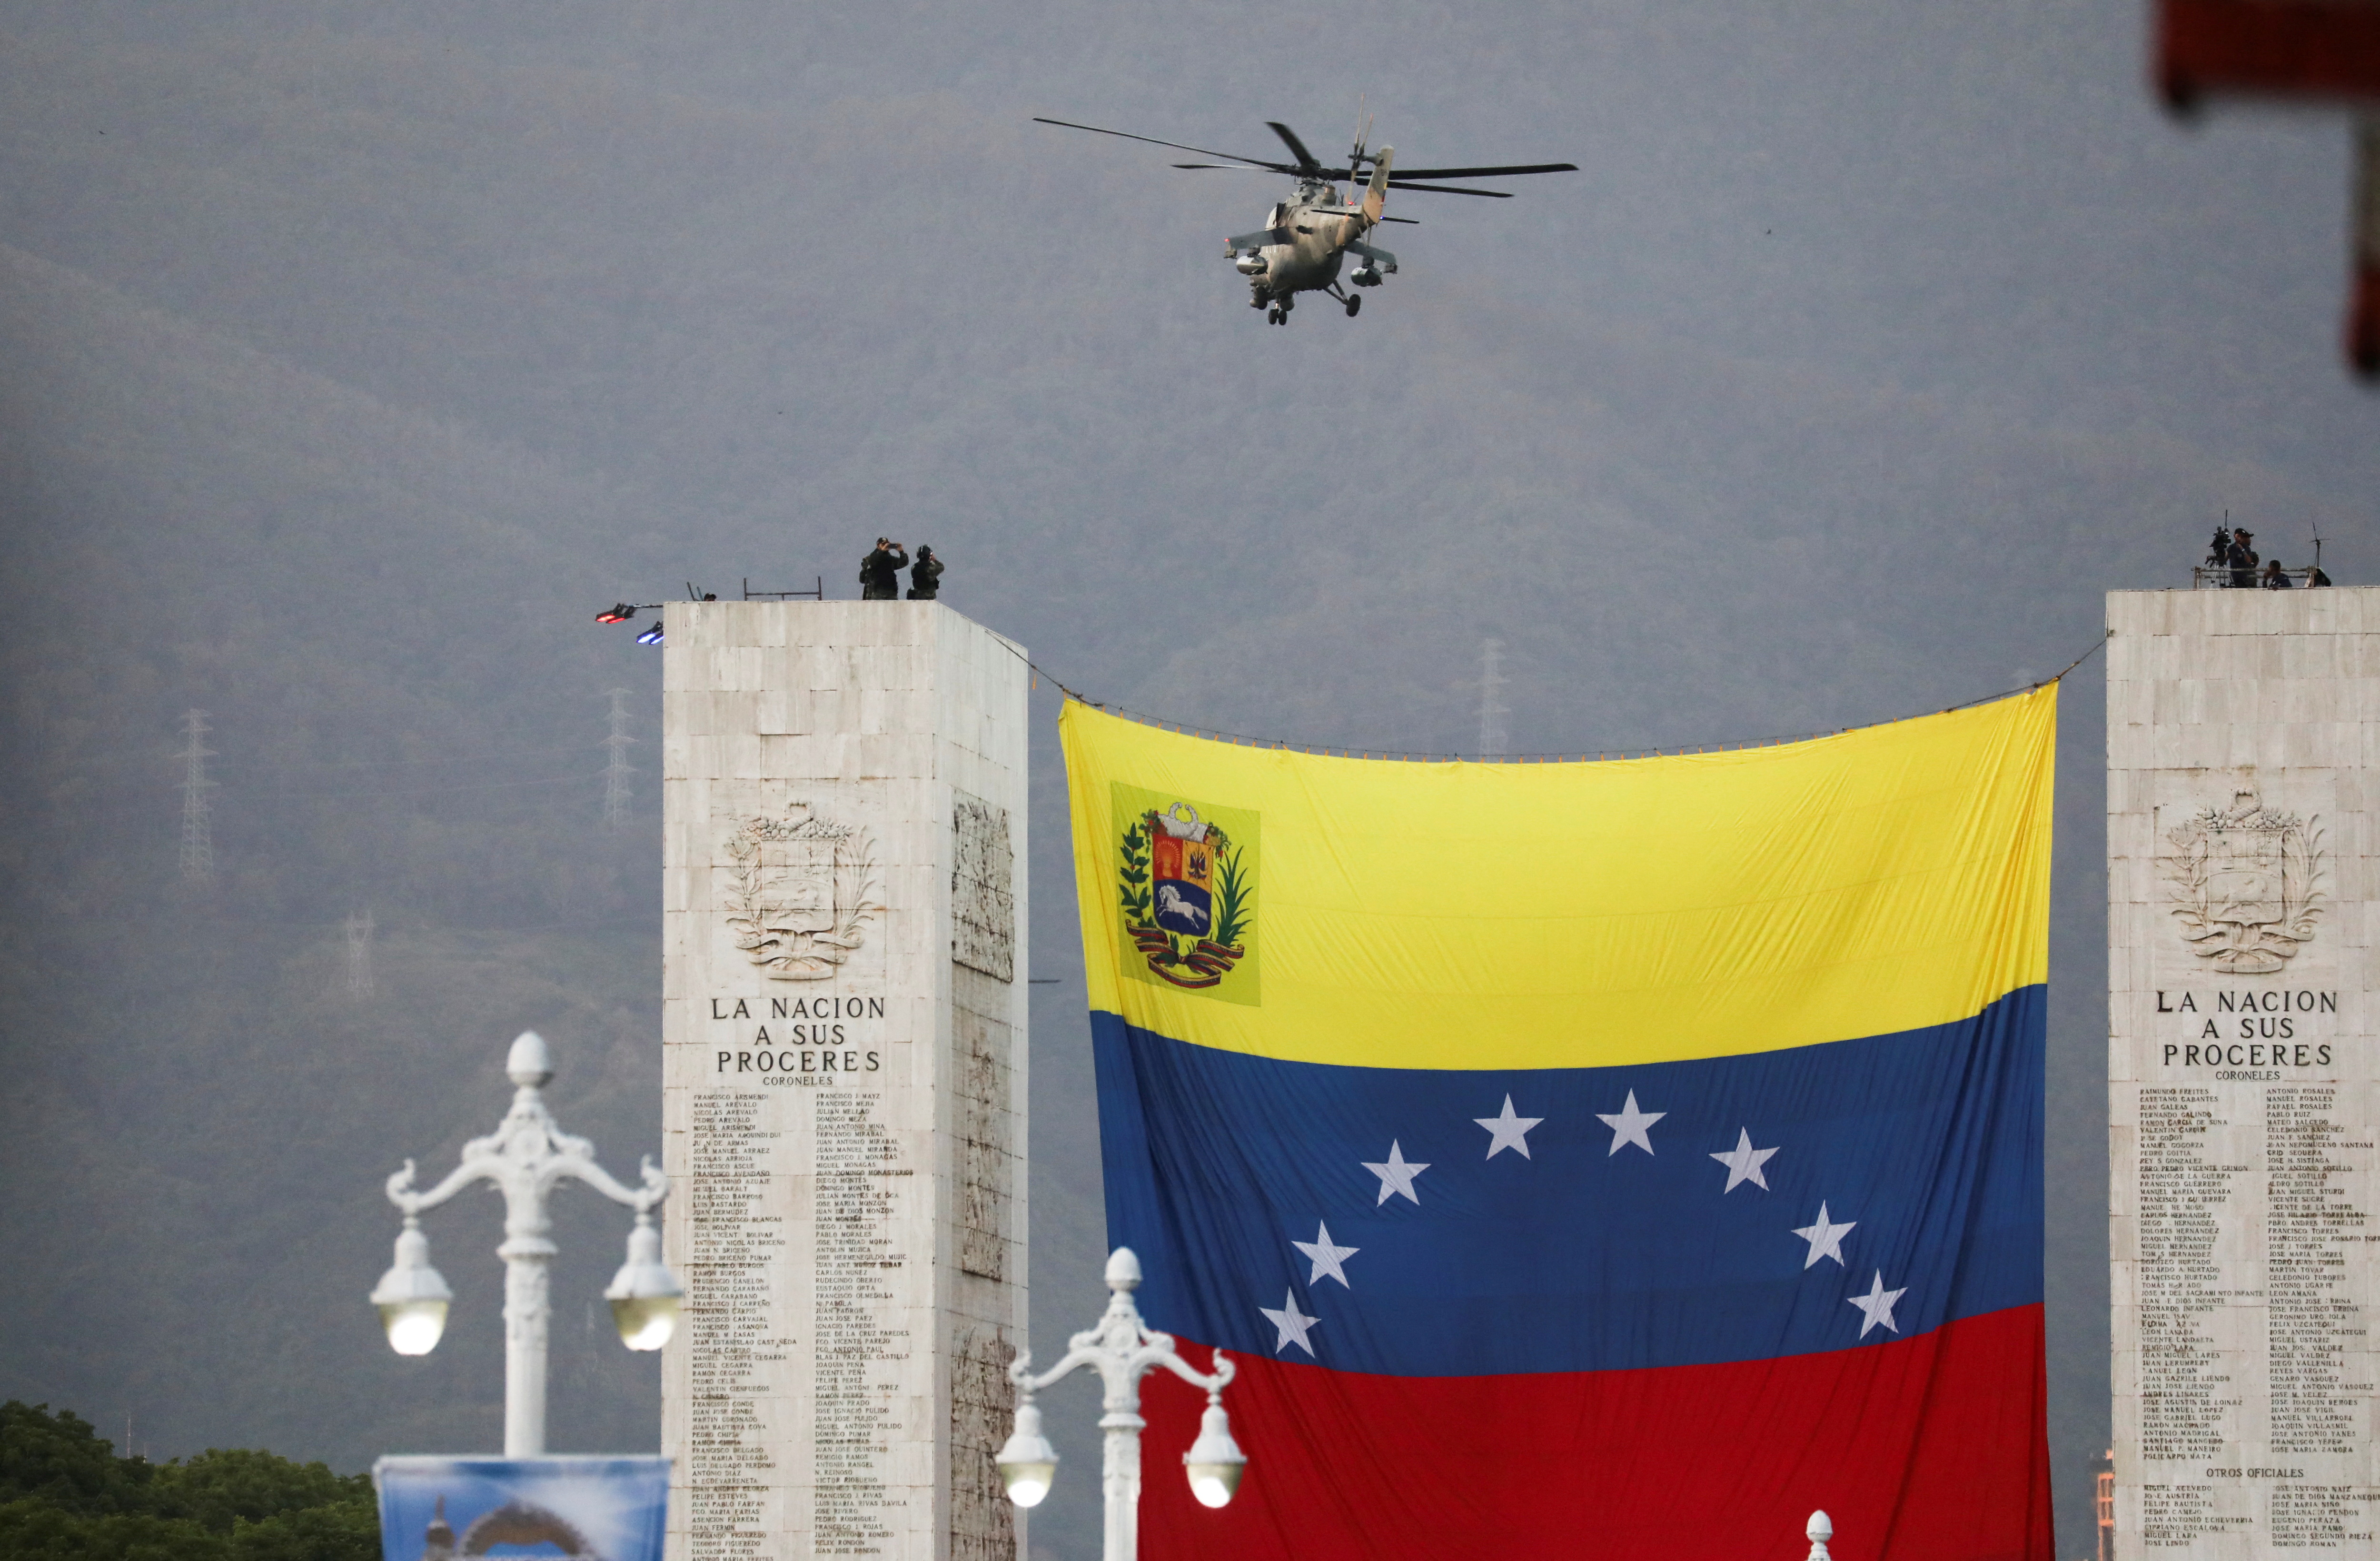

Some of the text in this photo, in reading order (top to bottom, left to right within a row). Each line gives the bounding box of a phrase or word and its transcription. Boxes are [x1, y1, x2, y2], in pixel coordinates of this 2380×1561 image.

[713, 997, 885, 1019] LA NACION
[2157, 990, 2337, 1013] LA NACION
[754, 1024, 845, 1045] A SUS
[2201, 1017, 2294, 1039] A SUS
[717, 1051, 880, 1073] PROCERES
[2163, 1044, 2331, 1066] PROCERES
[763, 1076, 833, 1086] CORONELES
[2215, 1071, 2281, 1081] CORONELES
[2206, 1468, 2304, 1478] OTROS OFICIALES
